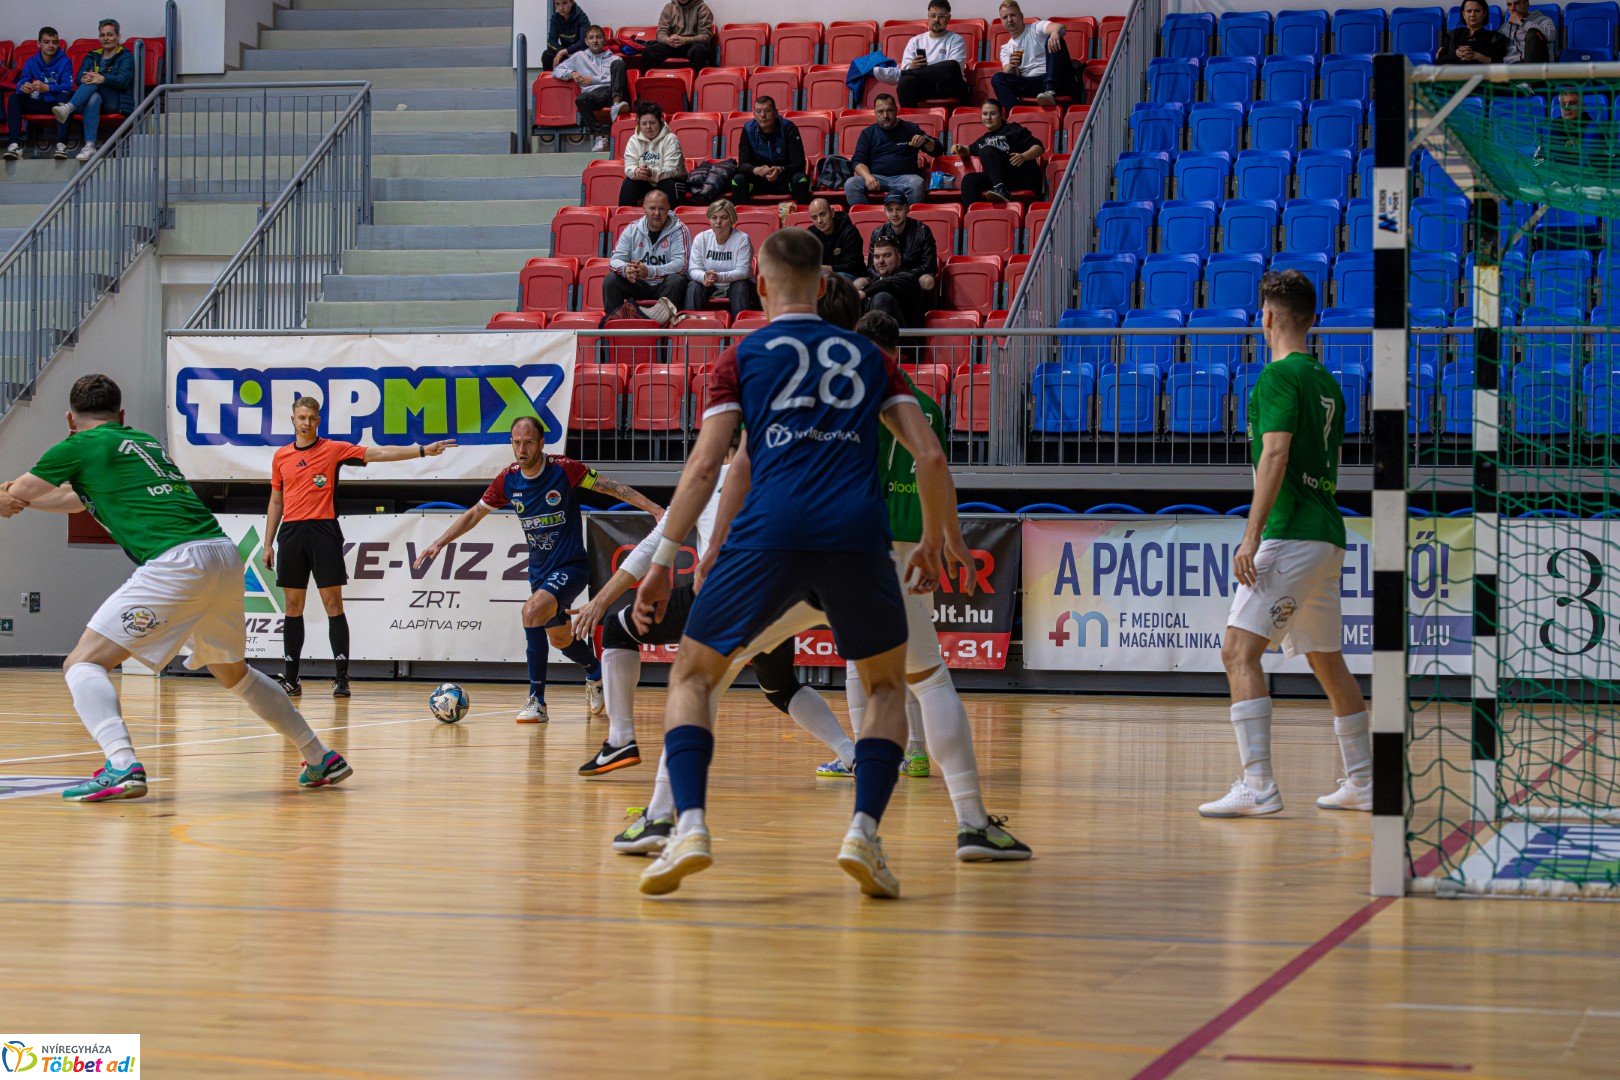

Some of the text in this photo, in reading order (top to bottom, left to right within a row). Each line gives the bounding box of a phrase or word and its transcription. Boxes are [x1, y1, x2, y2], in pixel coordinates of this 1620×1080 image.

[641, 252, 666, 266] AON
[706, 250, 732, 261] PUMA
[764, 336, 866, 411] 28
[1053, 541, 1081, 596] A
[547, 572, 569, 586] 33
[409, 590, 461, 609] ZRT.
[1539, 547, 1606, 656] 3
[390, 618, 482, 631] ALAPÍTVA 1991
[1119, 612, 1189, 629] F MEDICAL
[951, 639, 1002, 658] 31.
[1119, 629, 1222, 649] MAGÁNKLINIKA
